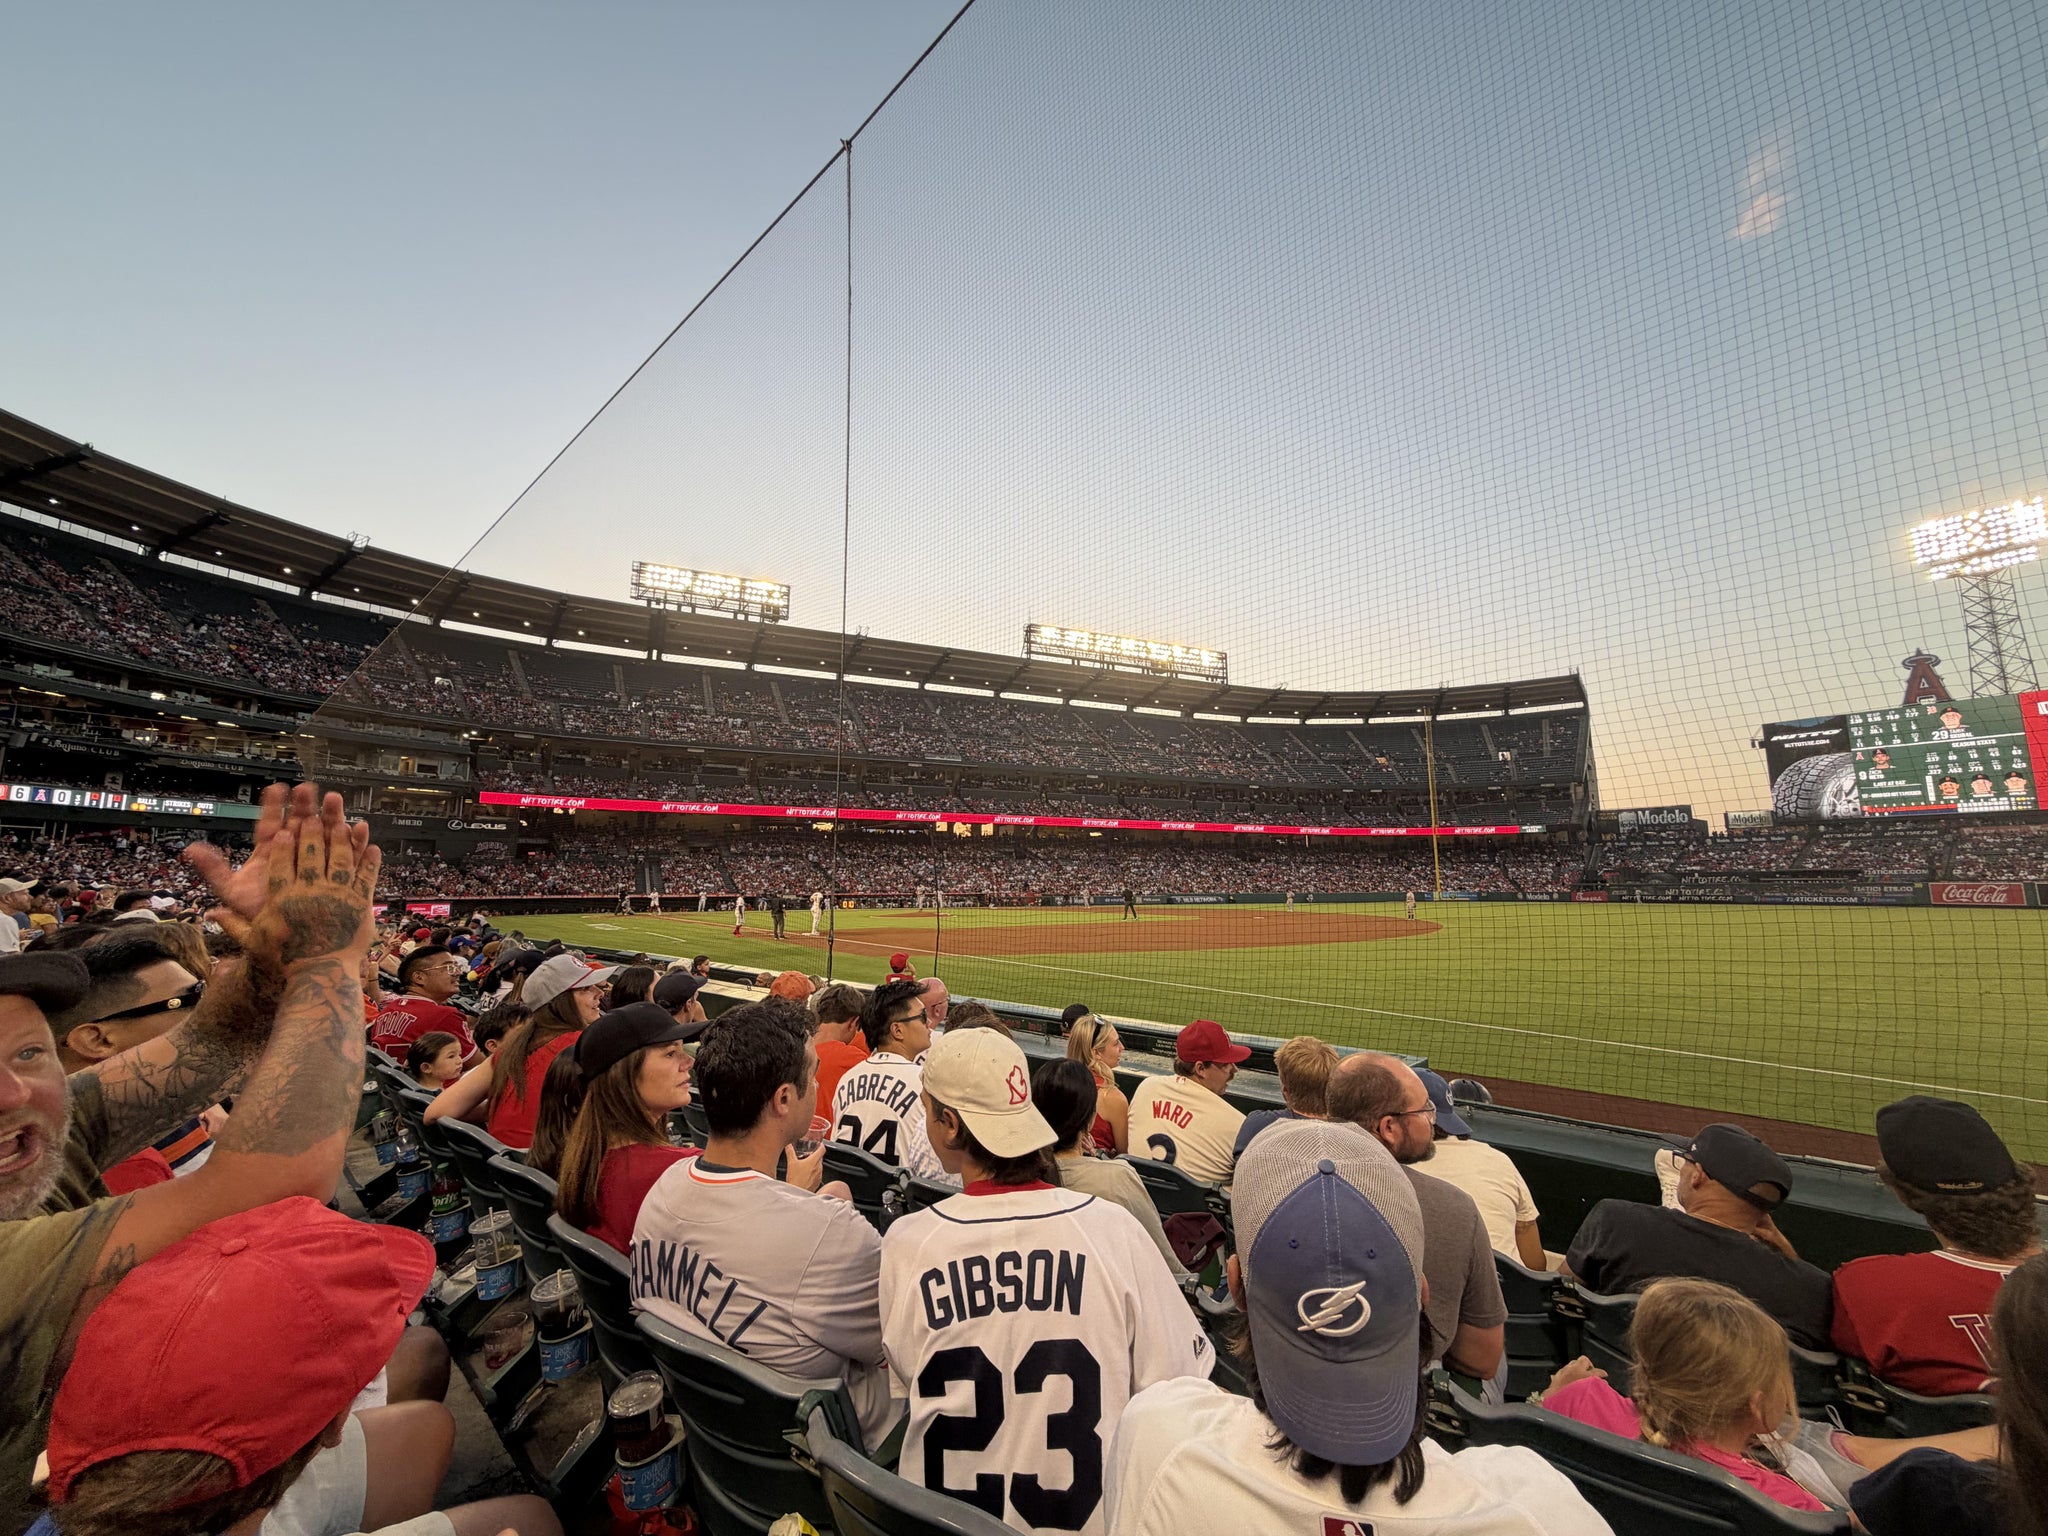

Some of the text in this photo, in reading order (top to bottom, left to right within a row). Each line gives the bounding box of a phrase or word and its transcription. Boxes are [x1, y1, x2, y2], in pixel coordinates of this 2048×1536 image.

[1770, 728, 1842, 741] NITTO
[1931, 730, 1949, 740] 29
[1951, 738, 1997, 748] SEASON STATS
[91, 748, 120, 756] CLUB
[218, 763, 244, 771] CLUB
[1858, 771, 1867, 780] 9
[16, 788, 25, 799] 6
[58, 791, 66, 802] 0
[520, 795, 585, 807] NITTOTIRE.COM
[165, 800, 191, 808] STRIKES
[662, 803, 719, 813] NITTOTIRE.COM
[786, 808, 836, 817] NITTOTIRE.COM
[1637, 809, 1689, 825] Modelo
[1733, 812, 1767, 824] Modelo
[464, 822, 506, 830] LEXUS
[1942, 884, 2009, 903] Coca-Cola
[377, 1011, 417, 1038] TROUT
[838, 1073, 919, 1119] CABRERA
[1152, 1100, 1194, 1130] WARD
[919, 1249, 1087, 1331] GIBSON
[918, 1338, 1103, 1531] 23
